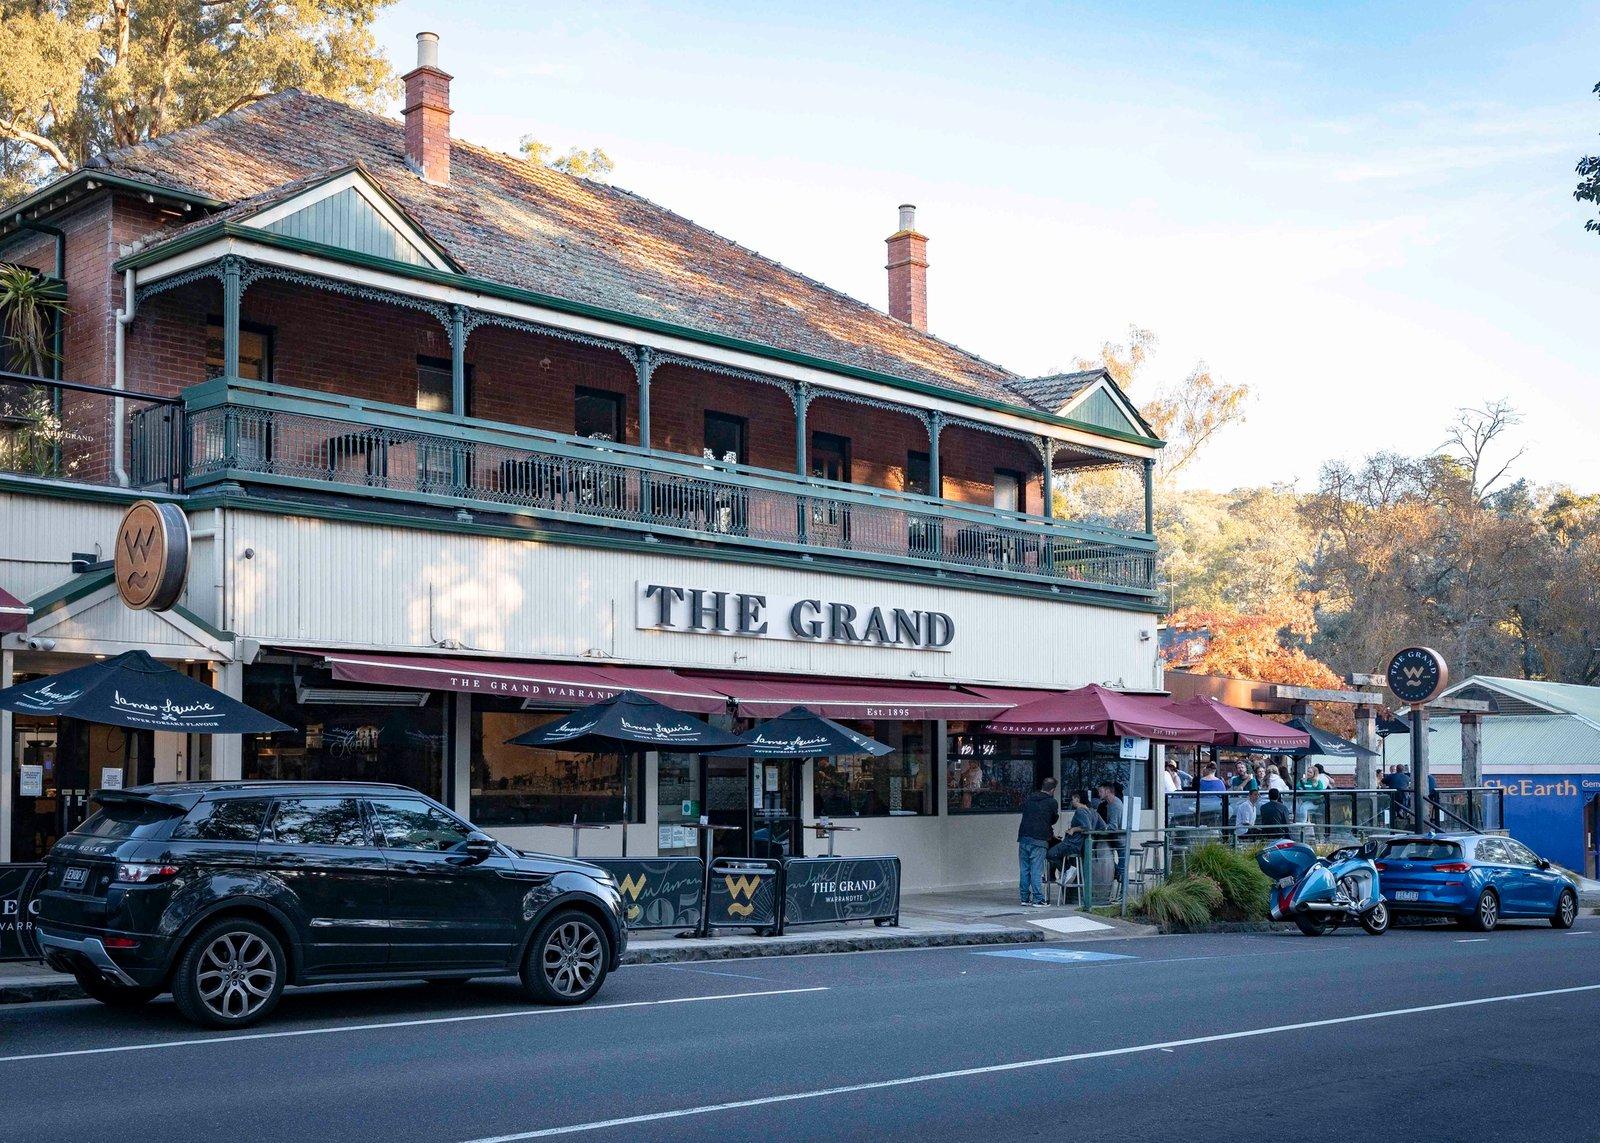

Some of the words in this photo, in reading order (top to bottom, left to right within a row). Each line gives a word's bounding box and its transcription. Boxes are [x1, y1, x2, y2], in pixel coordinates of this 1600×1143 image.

[124, 525, 156, 567] W
[646, 584, 769, 634] THE
[790, 598, 956, 648] GRAND
[1391, 655, 1406, 676] THE
[1407, 651, 1437, 674] GRAND
[1402, 666, 1425, 679] W
[450, 677, 480, 688] THE
[491, 681, 540, 694] GRAND
[547, 686, 620, 699] WARRAND
[867, 708, 886, 716] Est.
[888, 708, 910, 717] 1895
[1002, 725, 1033, 733] GRAND
[79, 845, 107, 853] ROVER
[724, 874, 761, 900] W
[812, 882, 836, 893] THE
[839, 880, 876, 892] GRAND
[825, 895, 863, 903] WARRANDYTE
